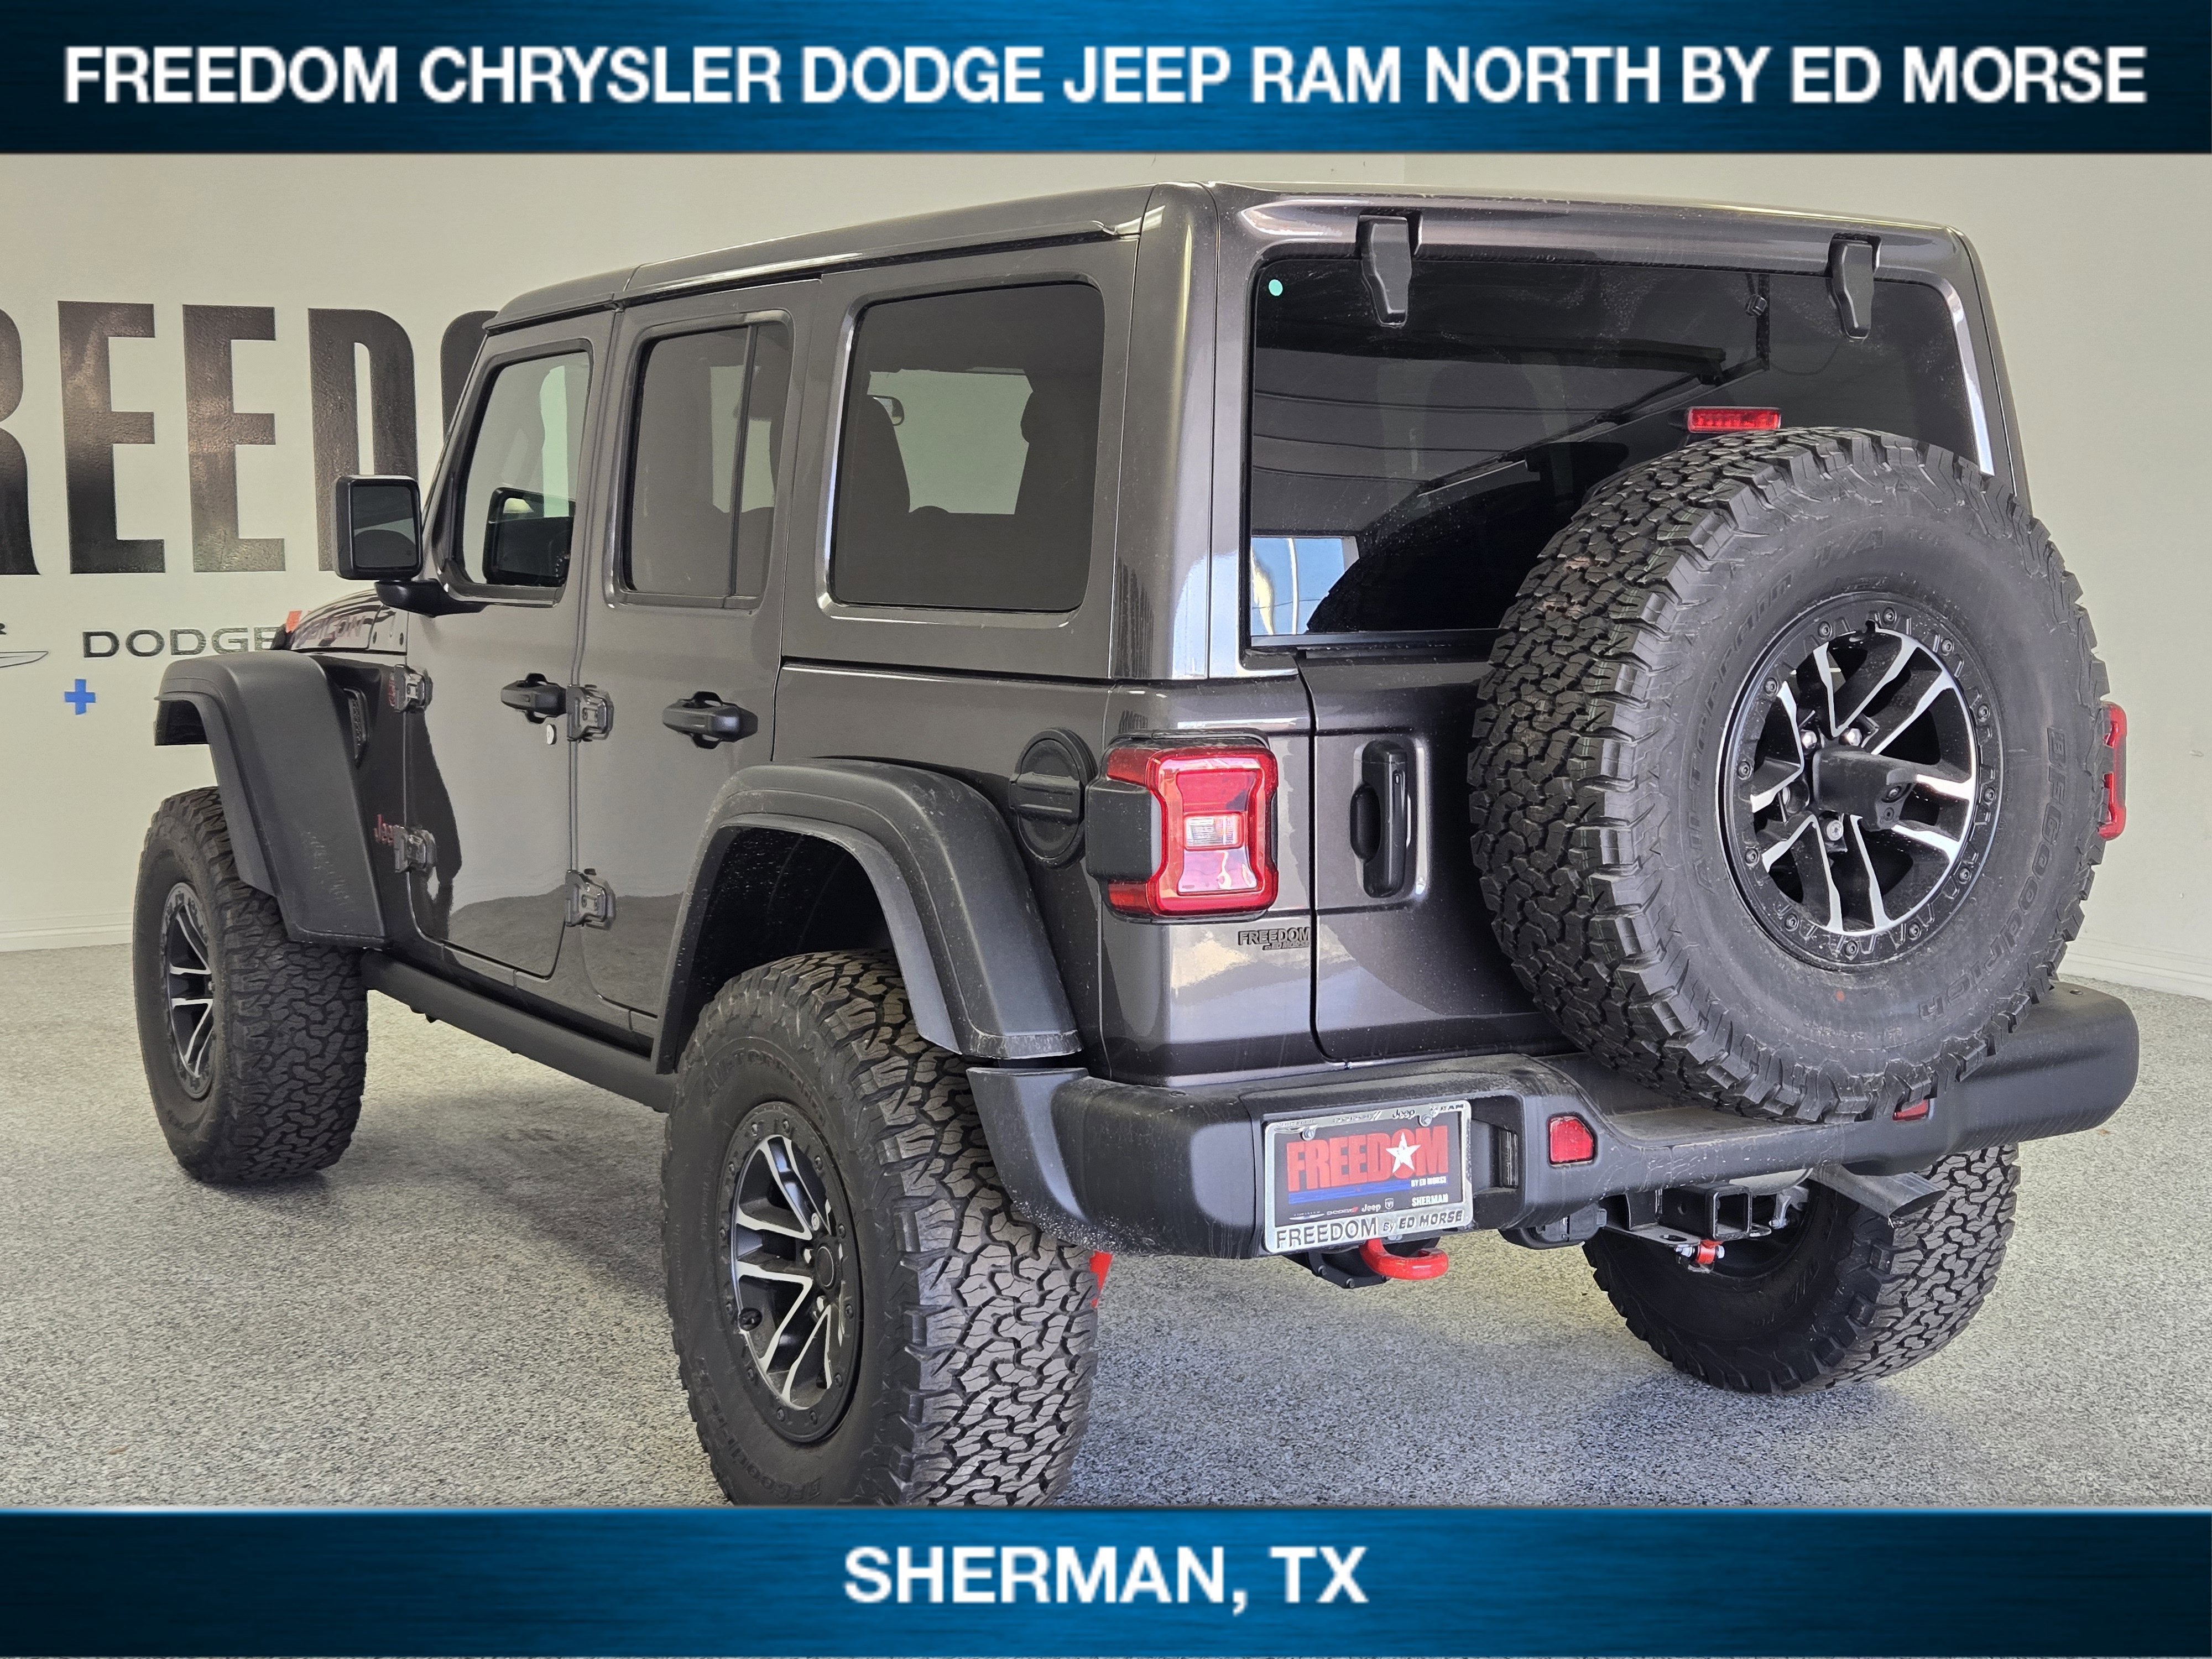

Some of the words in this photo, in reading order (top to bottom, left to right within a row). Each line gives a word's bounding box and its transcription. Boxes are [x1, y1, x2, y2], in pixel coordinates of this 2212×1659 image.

[82, 627, 282, 658] DODGE
[1918, 727, 2067, 1021] BFGoodrich
[1238, 927, 1311, 945] FREEDOM
[1287, 1125, 1449, 1192] FREEDOM
[1361, 1203, 1382, 1213] Jeep
[1411, 1193, 1449, 1207] SHERMAN
[1276, 1217, 1378, 1249] FREEDOM
[1399, 1217, 1415, 1229] ED
[1420, 1209, 1463, 1228] MORSE
